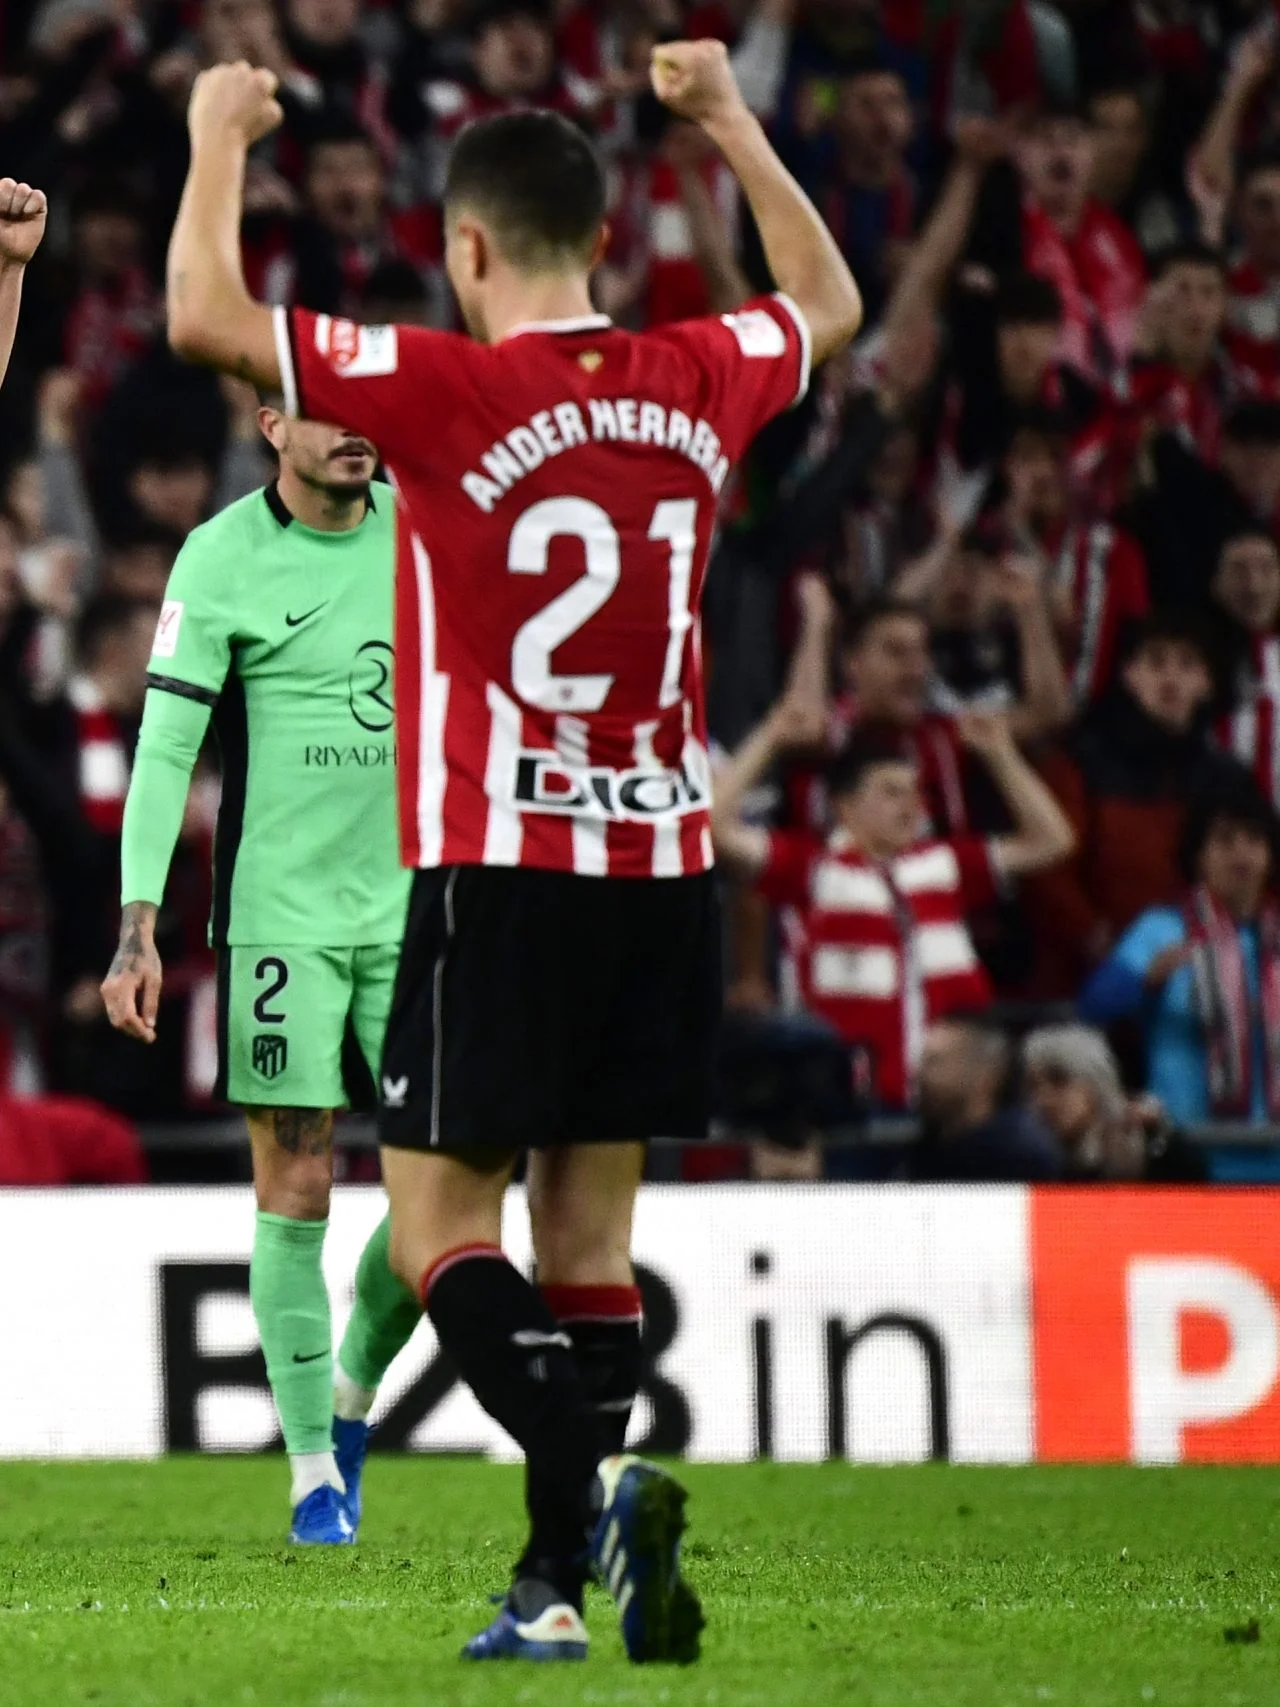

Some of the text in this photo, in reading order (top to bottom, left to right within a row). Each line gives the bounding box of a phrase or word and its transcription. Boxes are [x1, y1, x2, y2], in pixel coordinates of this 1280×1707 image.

[460, 401, 588, 513] ANDER
[507, 495, 700, 712] 21
[304, 744, 398, 767] RIYADH
[253, 956, 289, 1024] 2
